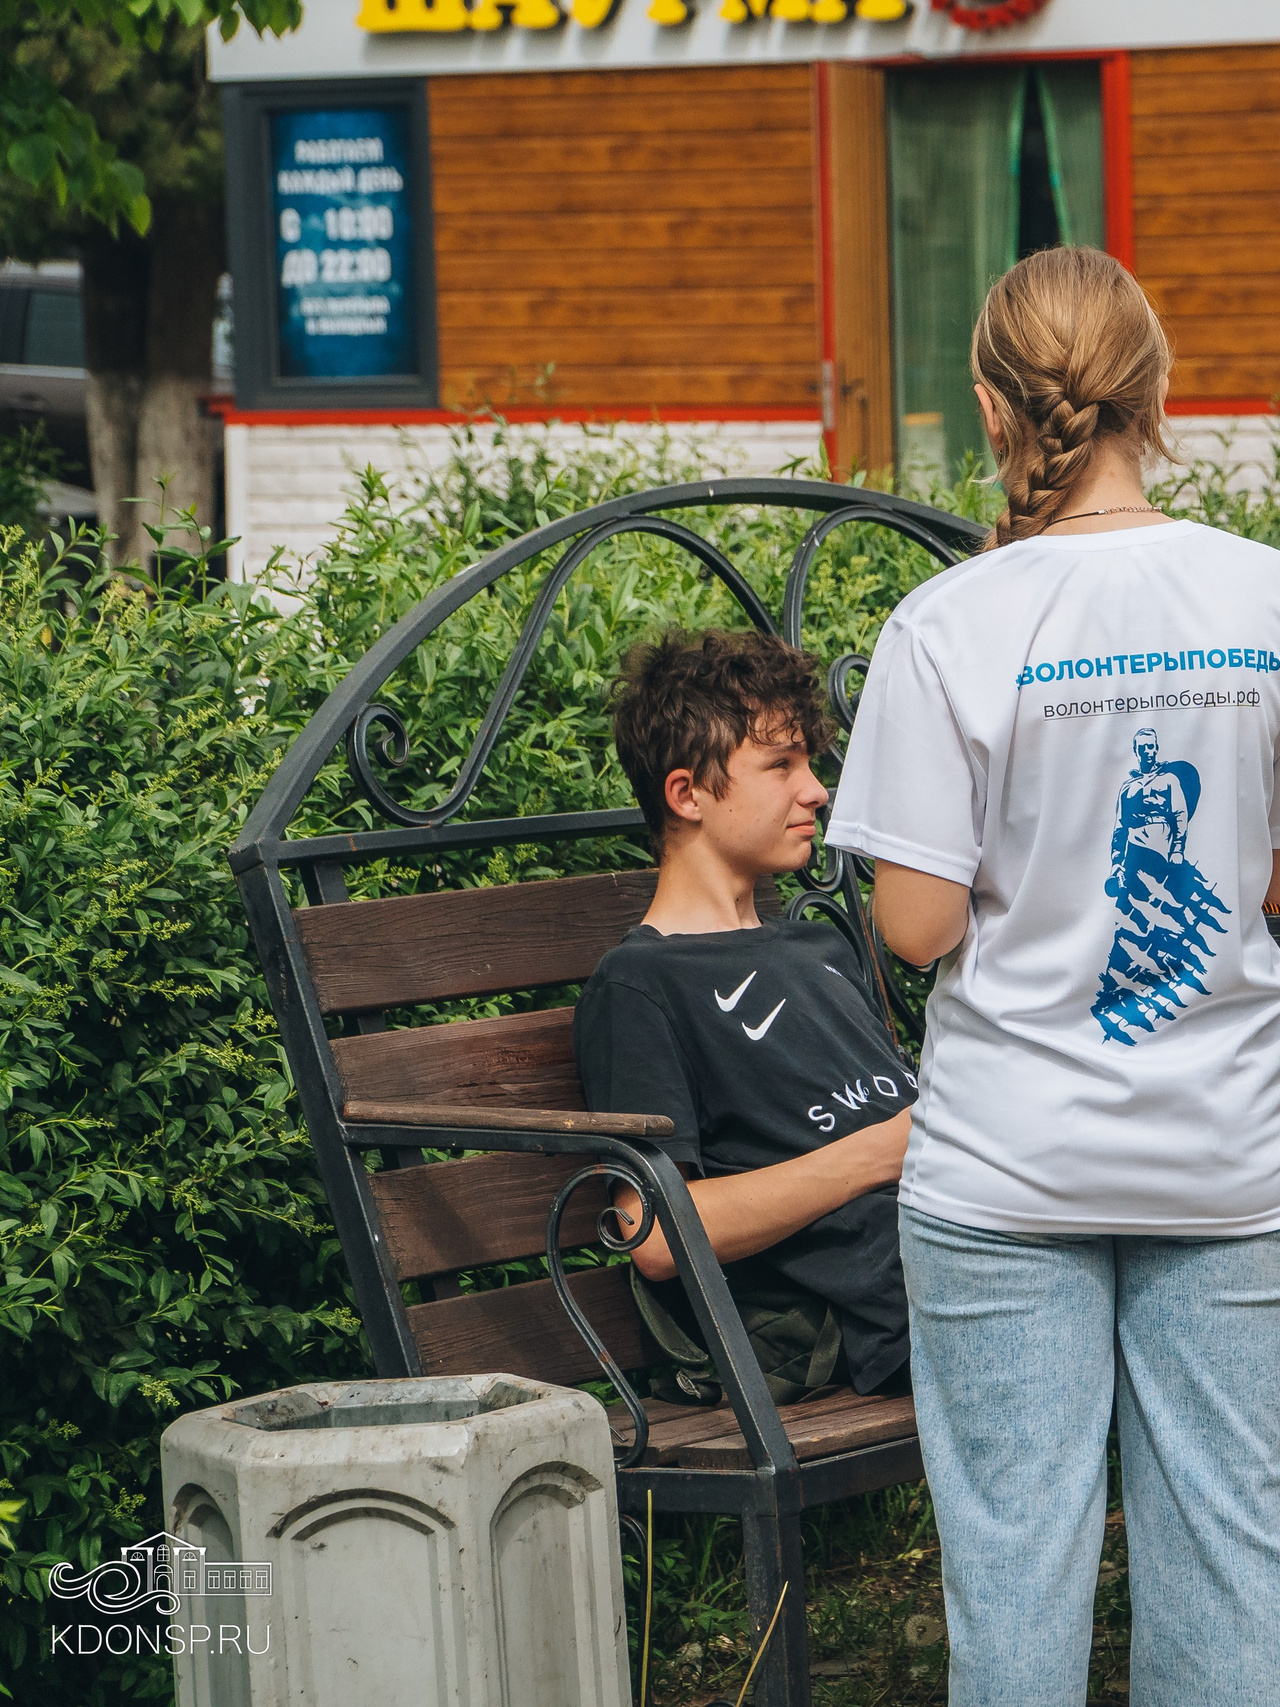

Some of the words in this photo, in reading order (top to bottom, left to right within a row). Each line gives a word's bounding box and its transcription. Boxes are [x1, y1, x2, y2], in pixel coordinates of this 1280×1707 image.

[357, 167, 404, 194] ДЕНЬ
[279, 207, 301, 243] С
[281, 248, 318, 288] ДО
[320, 247, 392, 283] 22:00
[1044, 688, 1261, 719] волонтерыпобеды.рф
